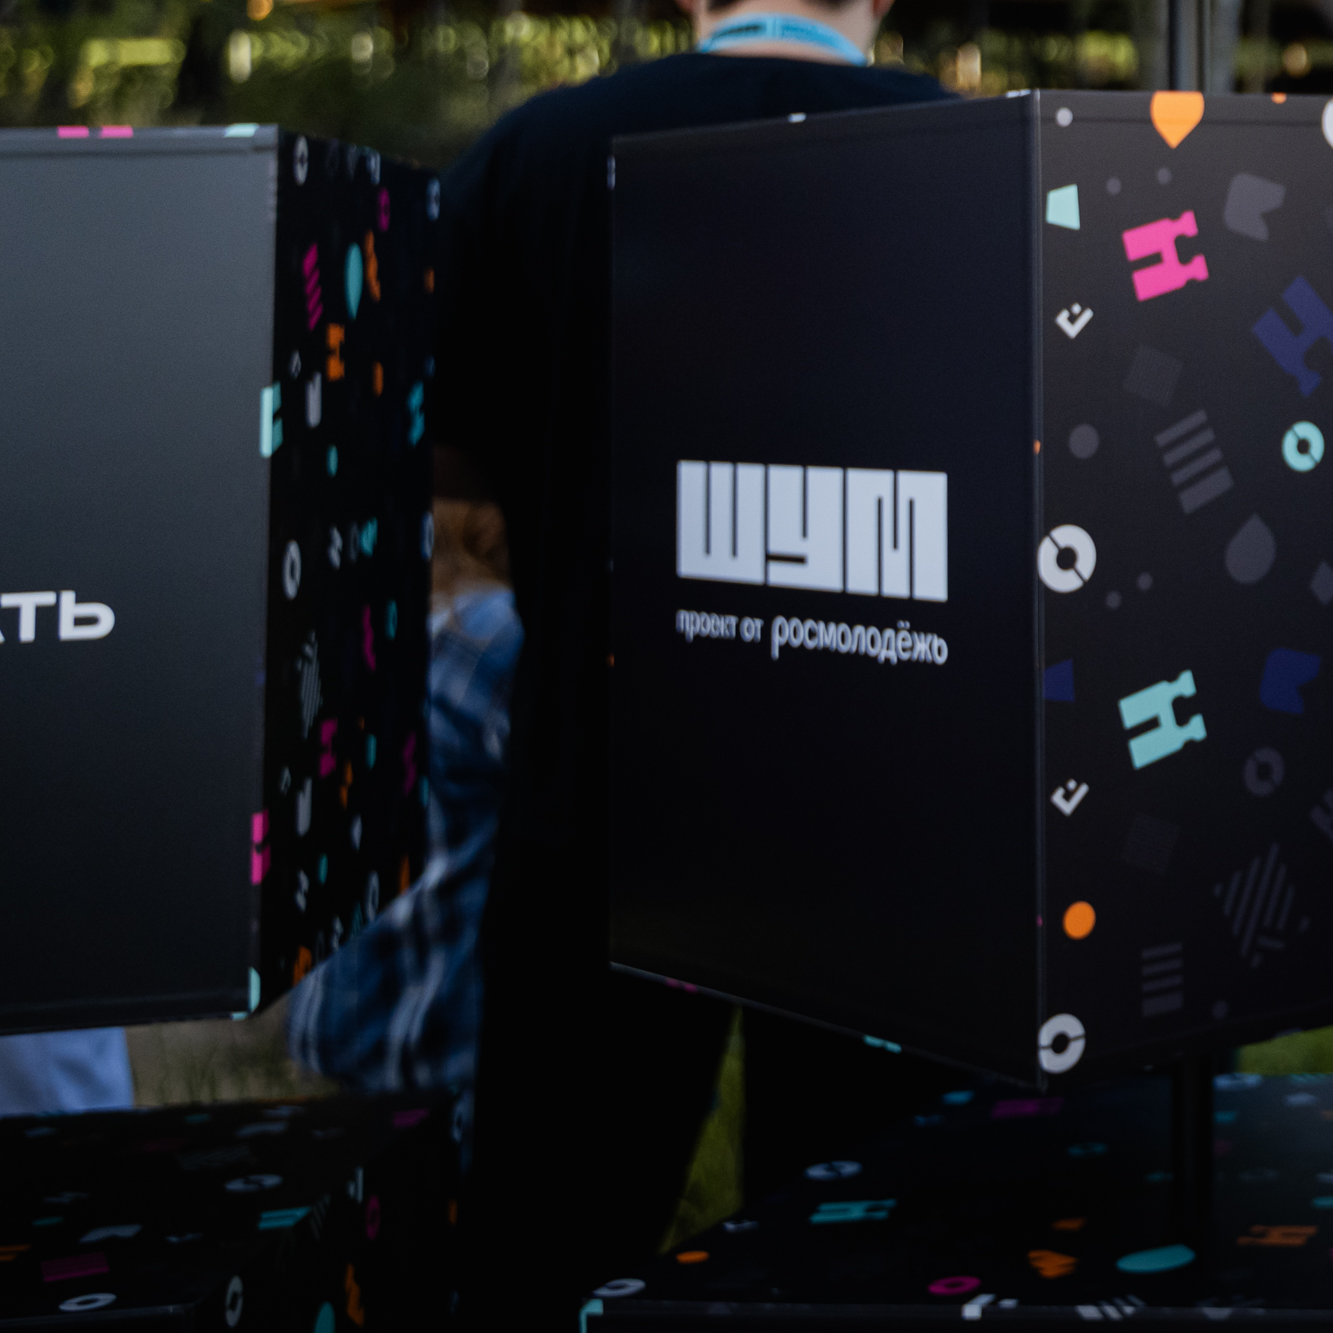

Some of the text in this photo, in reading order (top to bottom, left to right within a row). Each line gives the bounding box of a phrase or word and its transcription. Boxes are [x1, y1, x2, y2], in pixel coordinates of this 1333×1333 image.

[676, 459, 948, 602] ШУМ
[0, 589, 115, 644] ТЬ
[675, 609, 949, 665] проект от росмолодёжь
